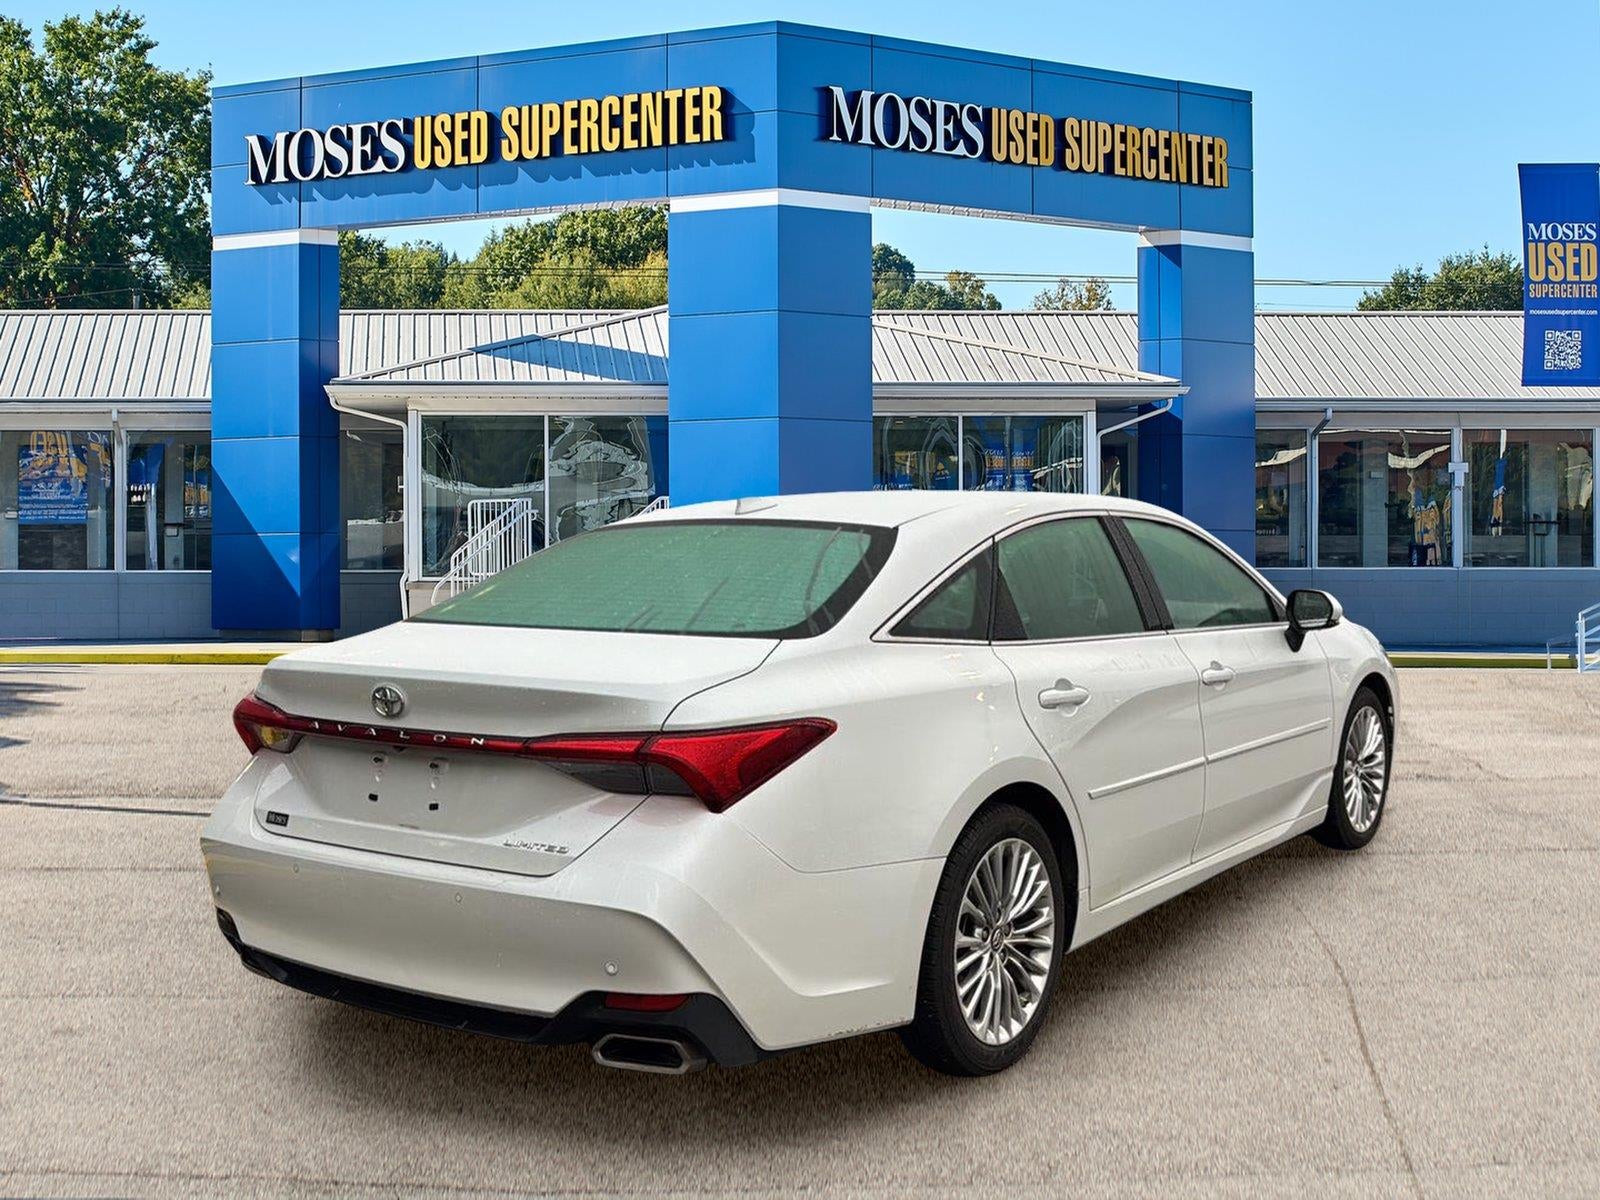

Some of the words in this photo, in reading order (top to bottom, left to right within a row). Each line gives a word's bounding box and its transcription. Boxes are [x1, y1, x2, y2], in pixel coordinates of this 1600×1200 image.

[244, 118, 406, 186] MOSES
[413, 110, 488, 171] USED
[501, 85, 724, 162] SUPERCENTER
[829, 85, 984, 159] MOSES
[991, 107, 1055, 168] USED
[1064, 117, 1229, 188] SUPERCENTER
[1528, 223, 1597, 241] MOSES
[1528, 242, 1598, 282] USED
[1529, 284, 1598, 298] SUPERCENTER
[309, 720, 486, 746] AVALON
